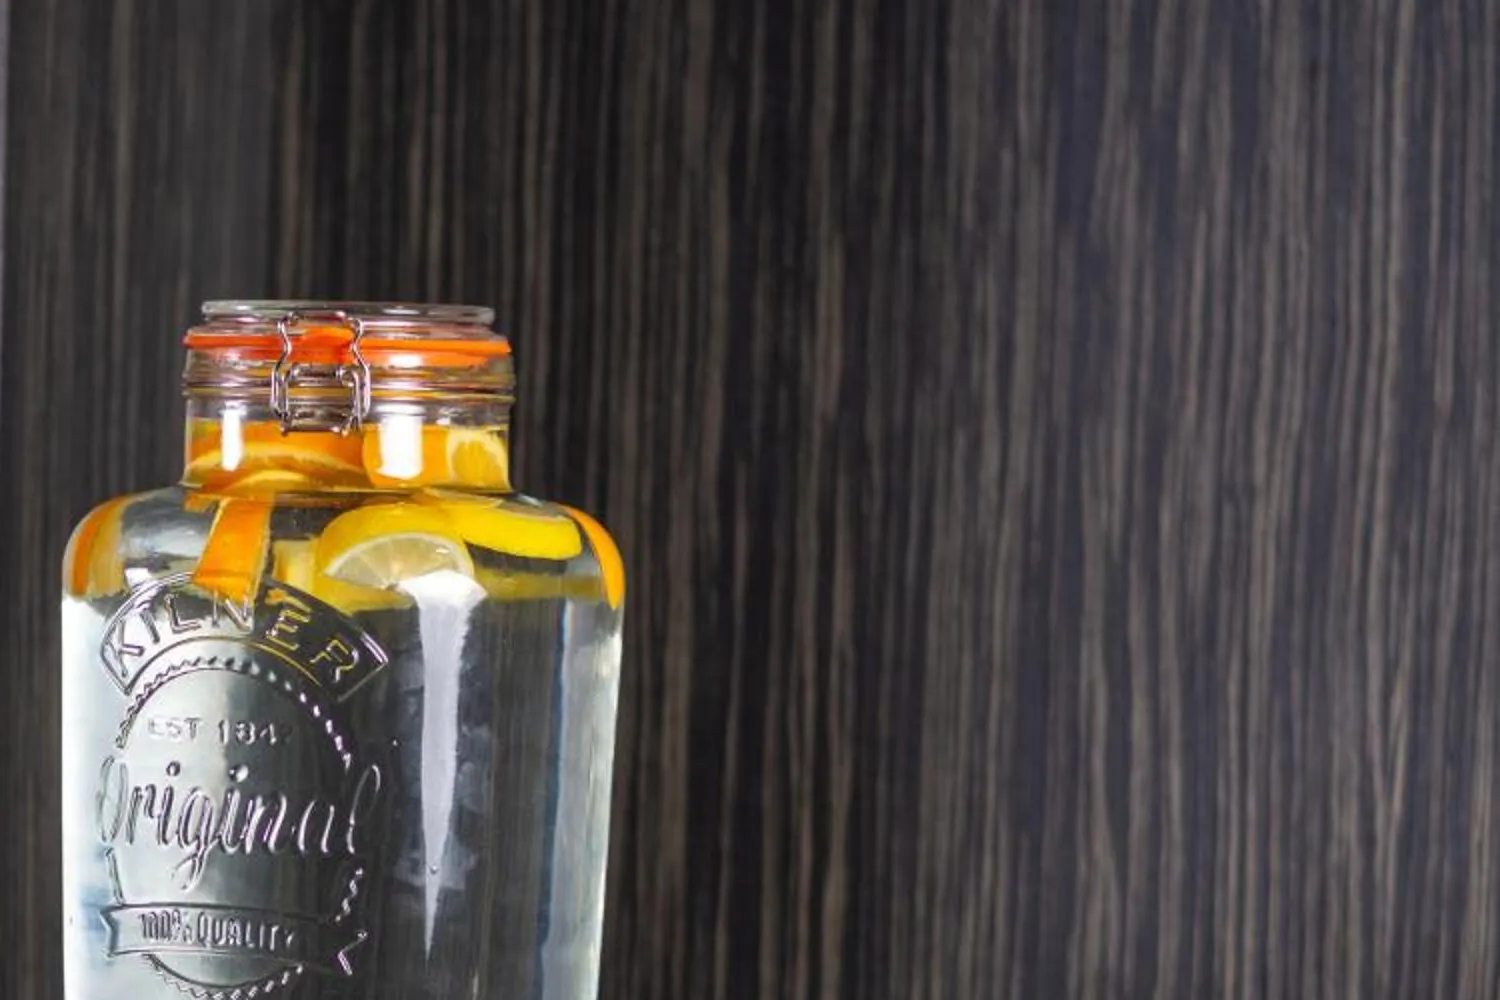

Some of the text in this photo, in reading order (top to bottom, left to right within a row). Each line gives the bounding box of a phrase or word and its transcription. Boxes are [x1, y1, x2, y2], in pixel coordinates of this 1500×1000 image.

[103, 587, 360, 680] KILNER
[148, 717, 201, 742] EST
[97, 756, 380, 891] Original
[198, 911, 294, 950] QUALITY
